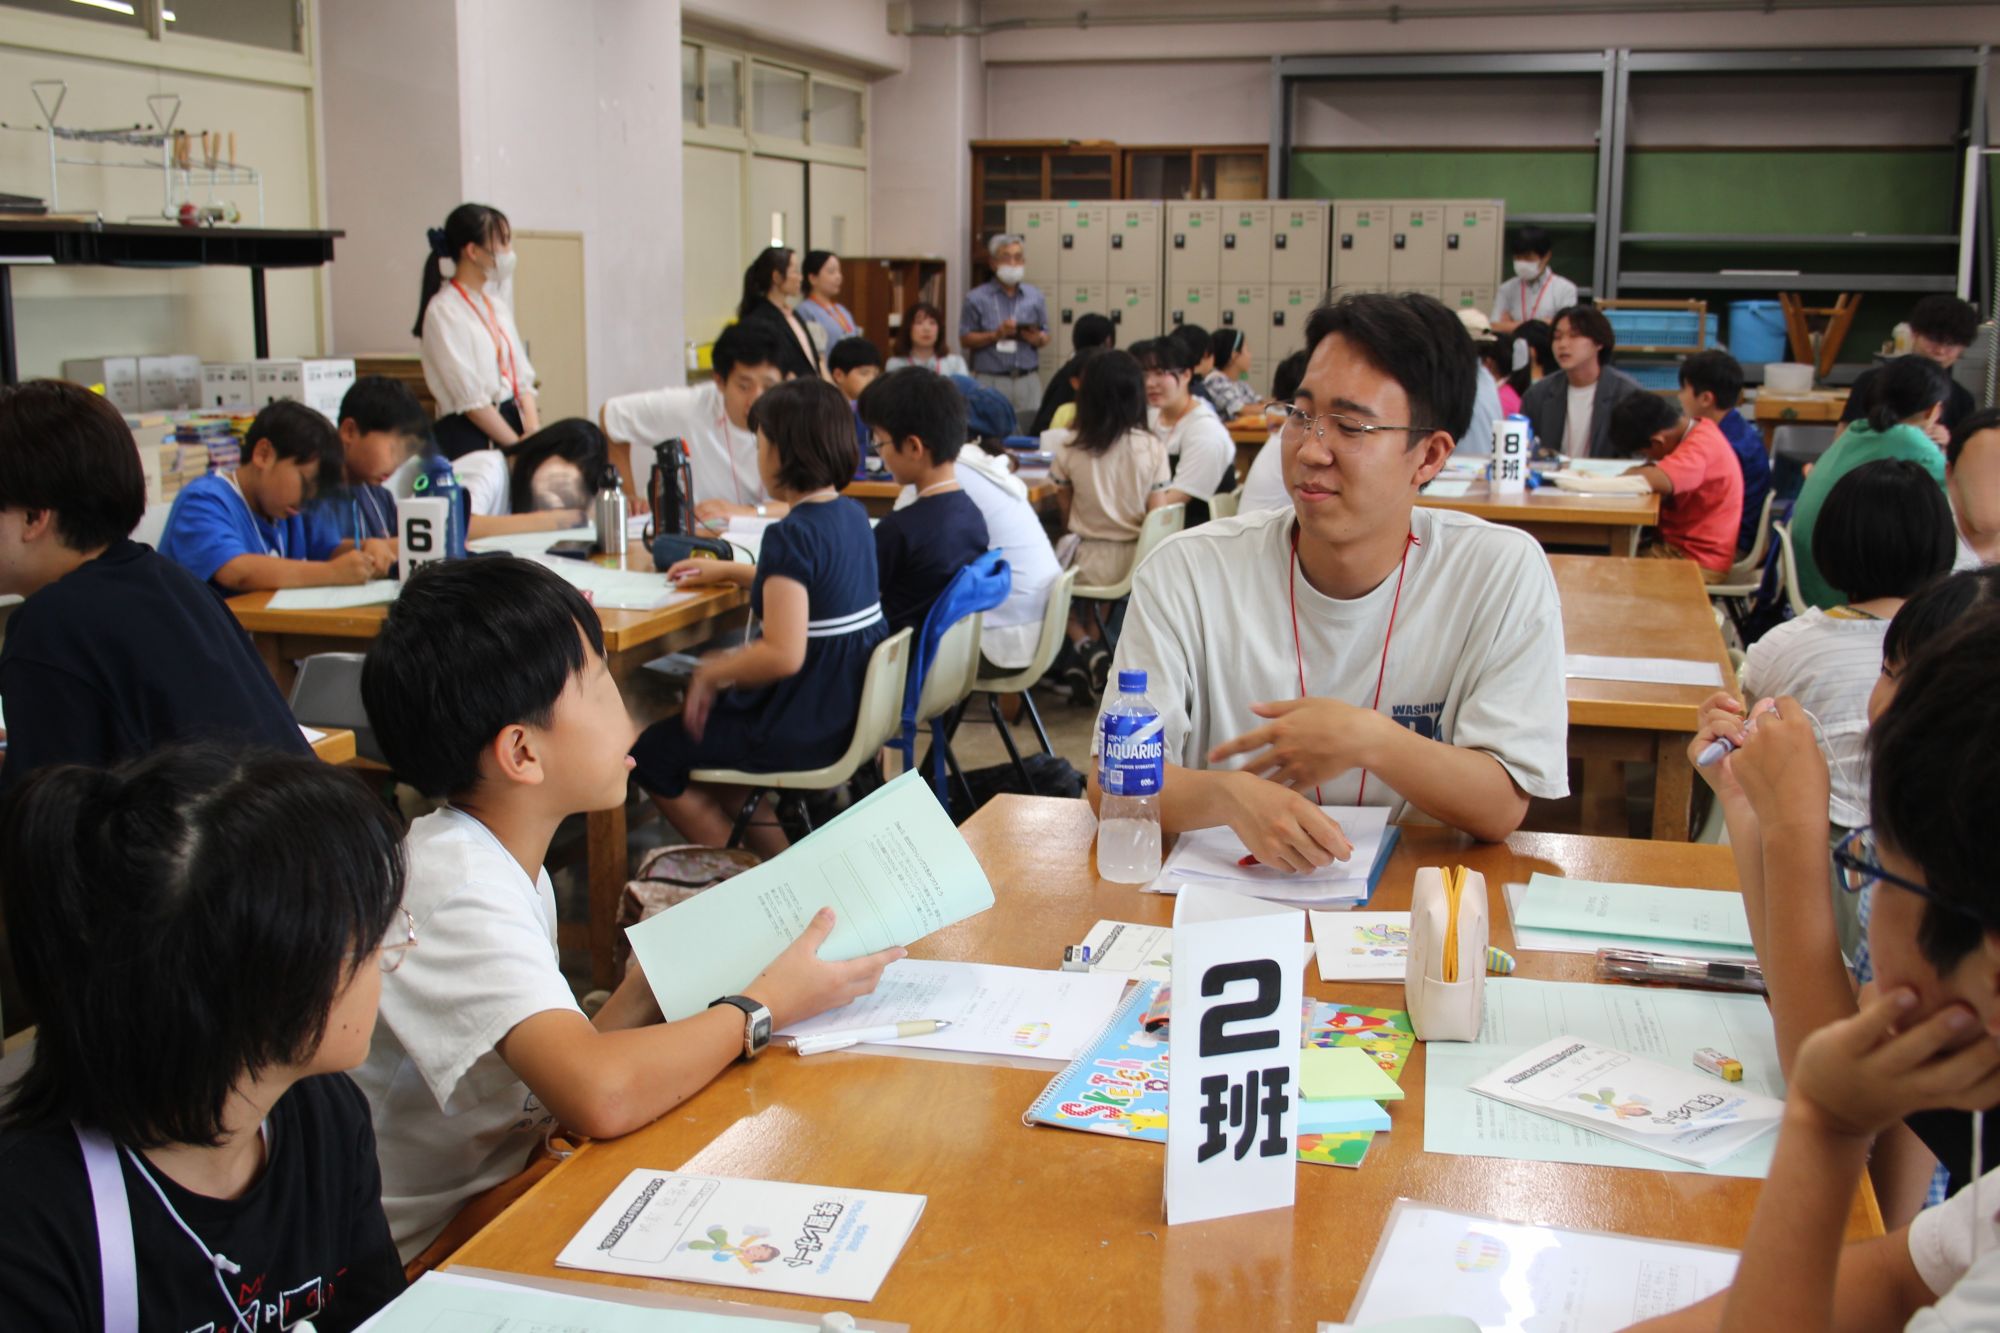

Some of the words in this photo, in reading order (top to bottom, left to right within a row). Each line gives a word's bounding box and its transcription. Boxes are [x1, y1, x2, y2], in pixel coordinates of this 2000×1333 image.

[1501, 433, 1520, 480] 8班
[1106, 741, 1161, 760] AQUARIUS
[1198, 959, 1290, 1163] 2班
[783, 1202, 844, 1268] 学習レポート
